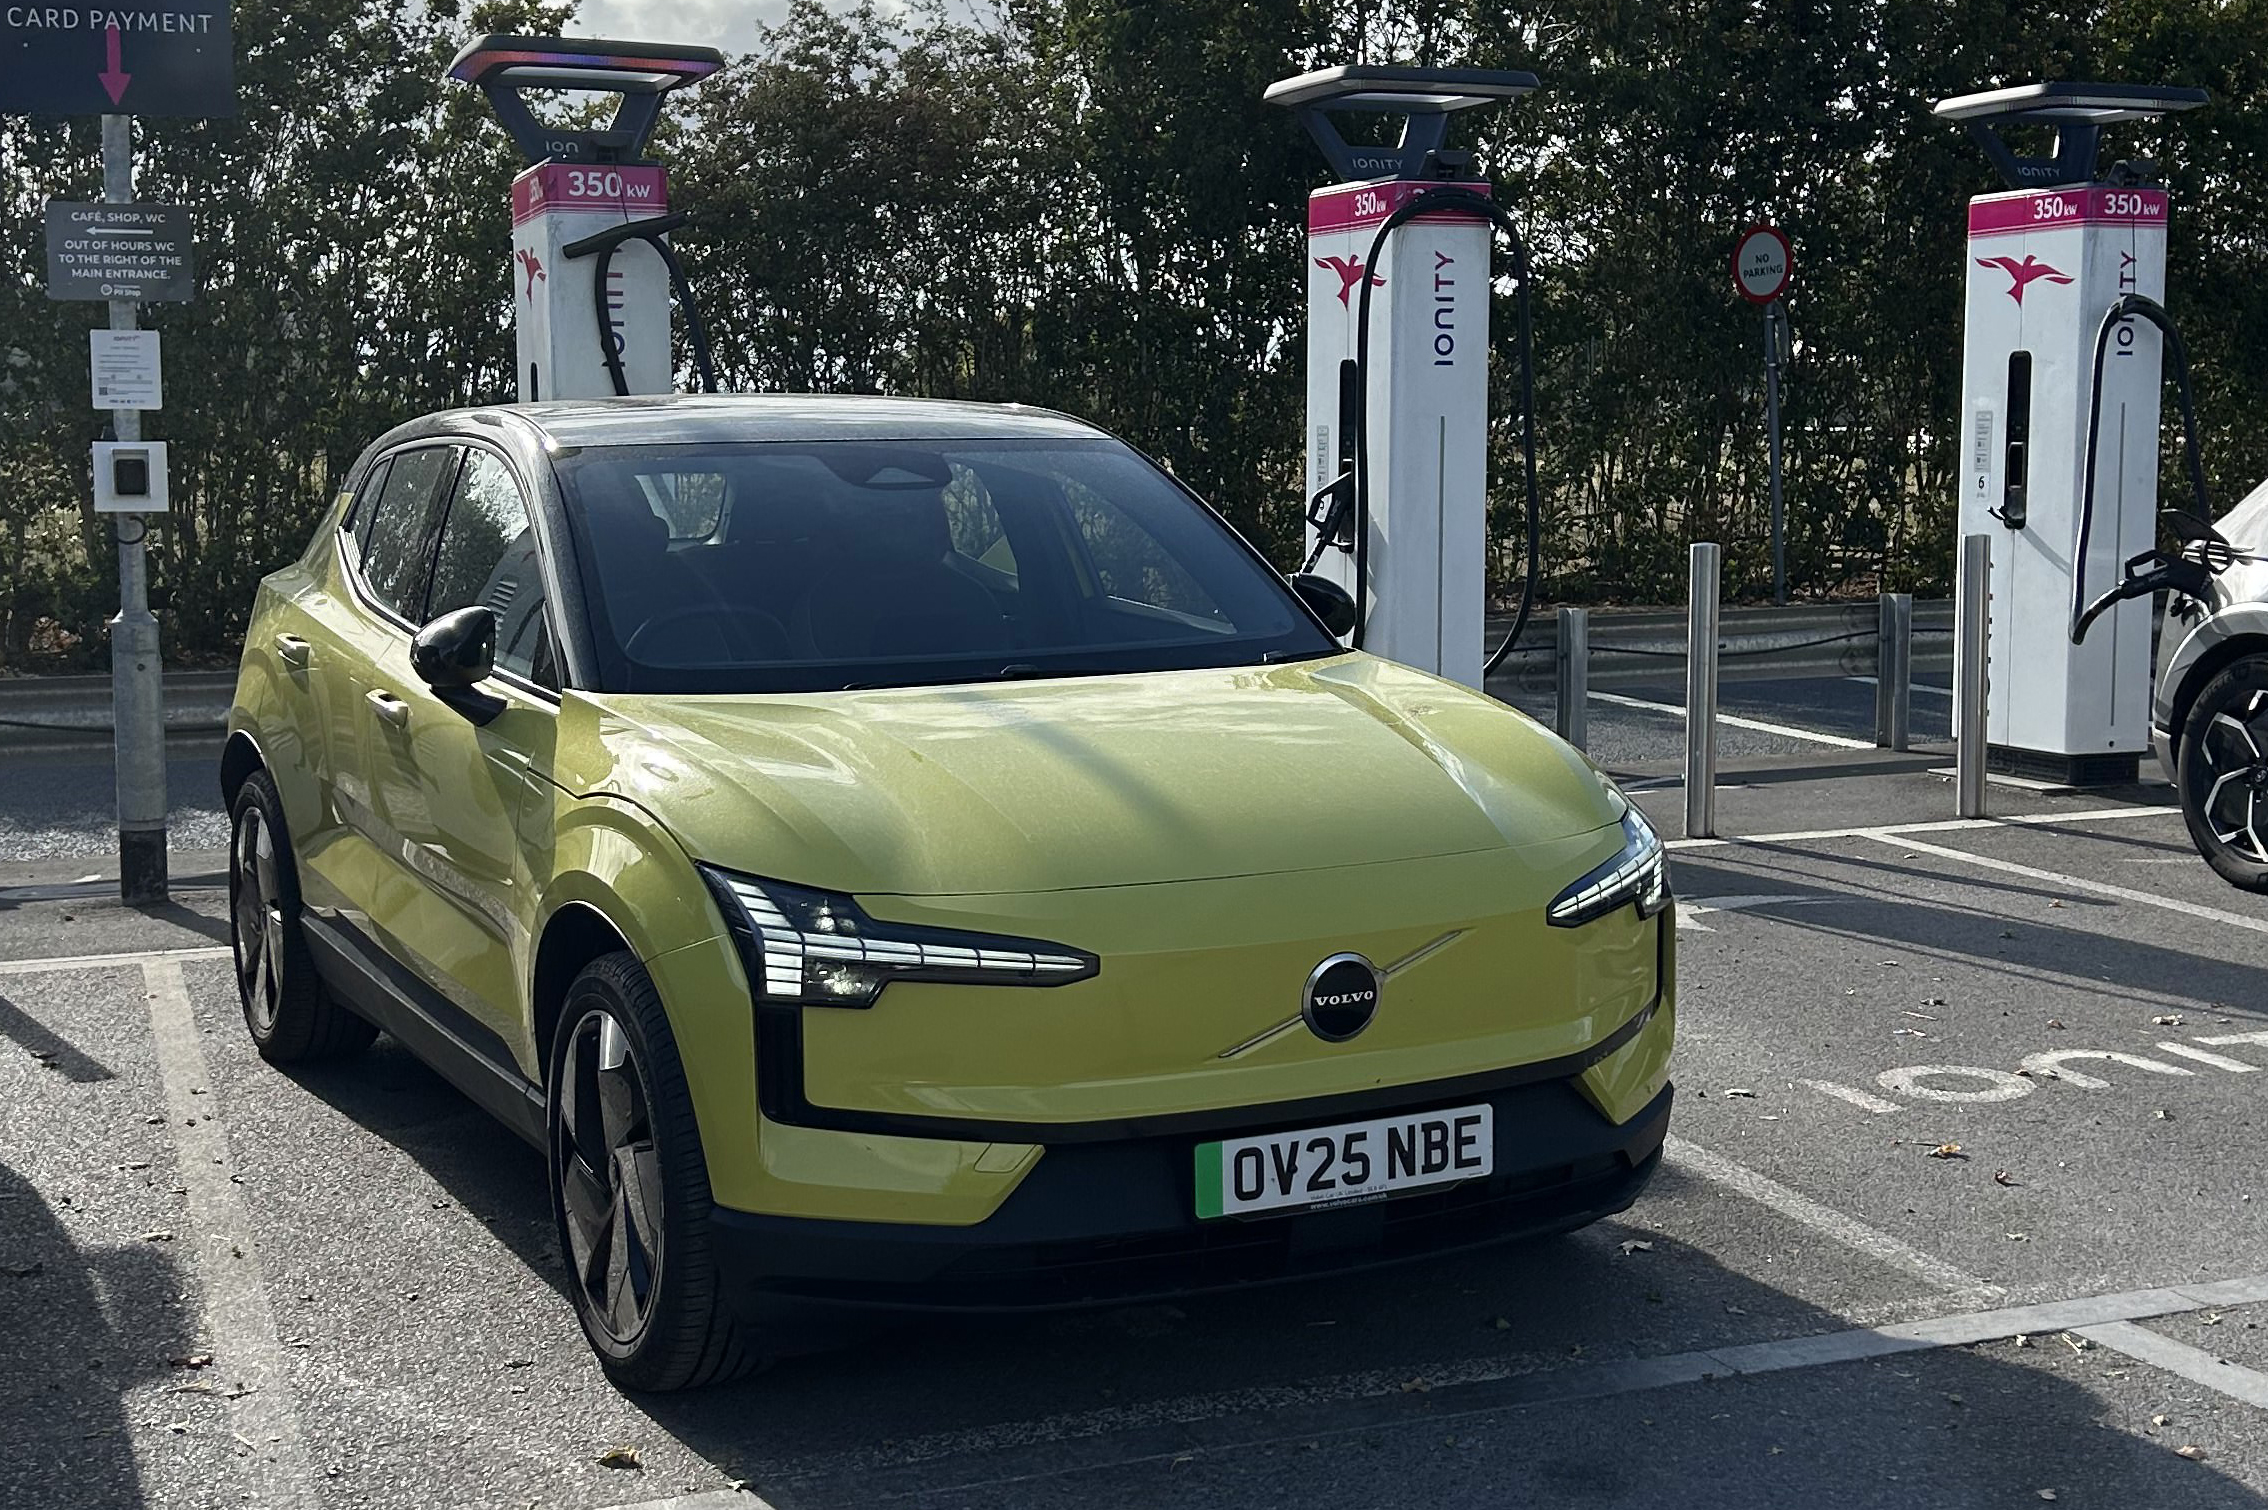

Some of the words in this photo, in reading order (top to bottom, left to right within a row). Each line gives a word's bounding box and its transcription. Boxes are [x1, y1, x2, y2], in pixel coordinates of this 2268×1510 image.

[7, 7, 79, 29] CARD
[90, 11, 213, 33] PAYMENT
[1352, 157, 1403, 170] IONITY
[2017, 166, 2061, 178] IONITY
[568, 171, 623, 197] 350
[626, 184, 651, 198] kW
[1354, 191, 1377, 217] 350
[2033, 196, 2063, 220] 350
[2063, 203, 2078, 217] kW
[2104, 193, 2142, 215] 350
[2143, 203, 2160, 216] kW
[107, 212, 144, 225] SHOP,
[145, 213, 166, 224] WC
[65, 240, 89, 250] OUT
[92, 240, 109, 250] OF
[111, 241, 152, 251] HOURS
[154, 242, 175, 252] WC
[58, 254, 75, 264] TO
[77, 254, 100, 264] THE
[103, 255, 138, 265] RIGHT
[140, 255, 157, 265] OF
[159, 256, 182, 266] THE
[1755, 253, 1770, 264] NO
[71, 268, 103, 278] MAIN
[105, 269, 171, 280] ENTRANCE.
[1743, 264, 1783, 279] PARKING
[1433, 250, 1455, 366] IONITY
[1978, 475, 1985, 490] 6
[1314, 990, 1374, 1007] VOLVO
[1234, 1130, 1371, 1202] OV25
[1387, 1114, 1482, 1180] NBE
